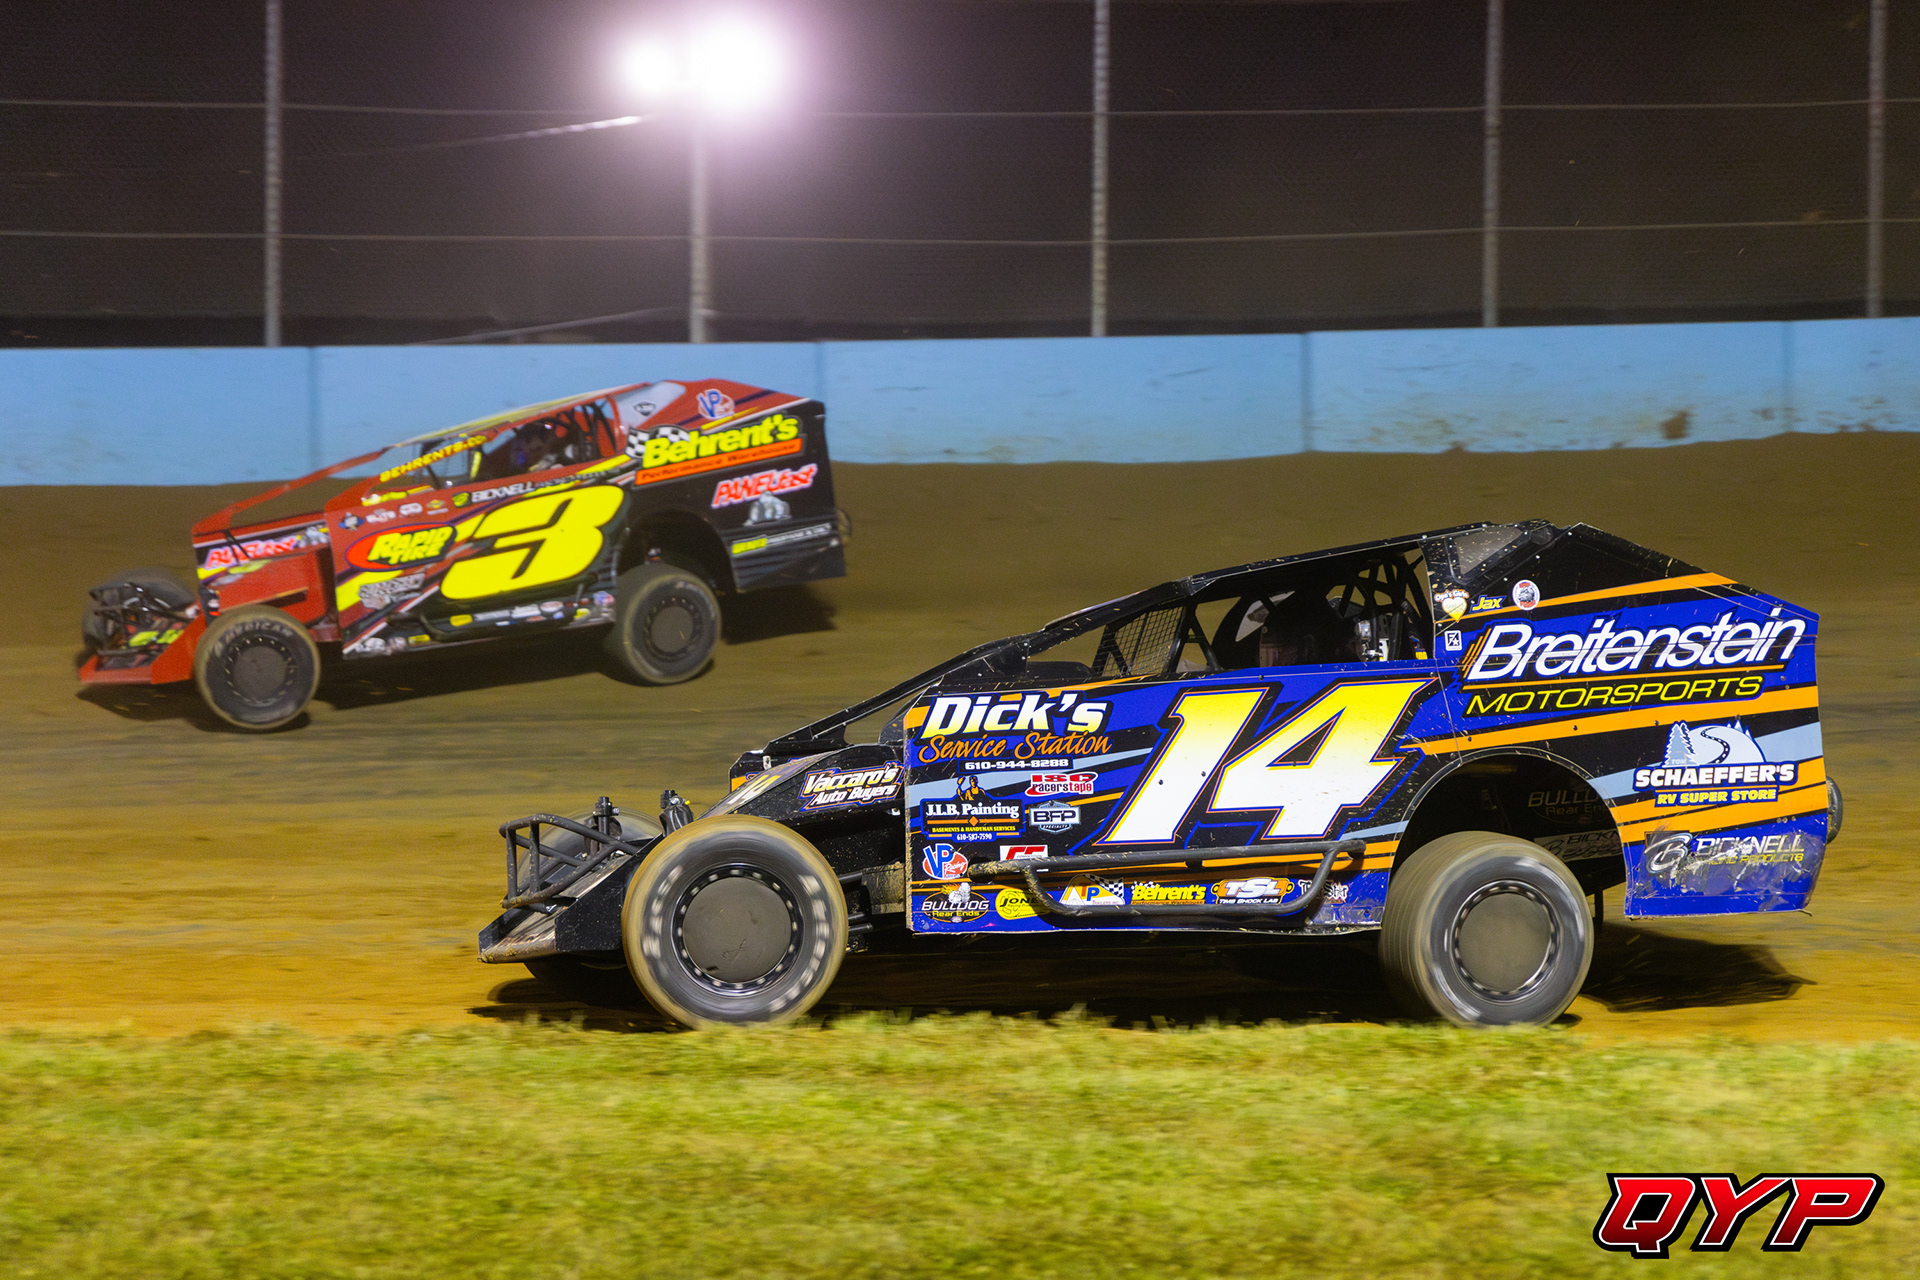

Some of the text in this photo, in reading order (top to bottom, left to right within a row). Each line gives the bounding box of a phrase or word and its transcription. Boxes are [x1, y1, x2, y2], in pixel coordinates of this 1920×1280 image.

[643, 414, 799, 469] Behrent's
[368, 526, 454, 561] RAPID
[440, 485, 624, 600] 3
[389, 543, 446, 565] TIRE
[1472, 597, 1503, 611] Jax
[1467, 607, 1806, 681] Breitenstein
[1466, 676, 1763, 714] MOTORSPORTS
[921, 693, 1108, 739] Dick's
[919, 731, 1113, 763] Service Station
[965, 758, 1069, 770] 610-944-8288
[1096, 679, 1434, 844] 14
[804, 763, 899, 794] Vaccaro's
[1635, 764, 1795, 788] SCHAEFFER'S
[810, 785, 897, 806] Auto Buyers
[1528, 788, 1601, 808] BULLD
[1657, 789, 1777, 805] RV SUPER STORE
[926, 802, 1020, 818] J.L.B. Painting
[1034, 810, 1076, 822] BFP
[923, 843, 955, 878] VP
[1132, 885, 1206, 900] Behrent's
[1225, 878, 1280, 898] TSL
[922, 900, 990, 911] BULLDOG
[1000, 898, 1042, 907] JONE
